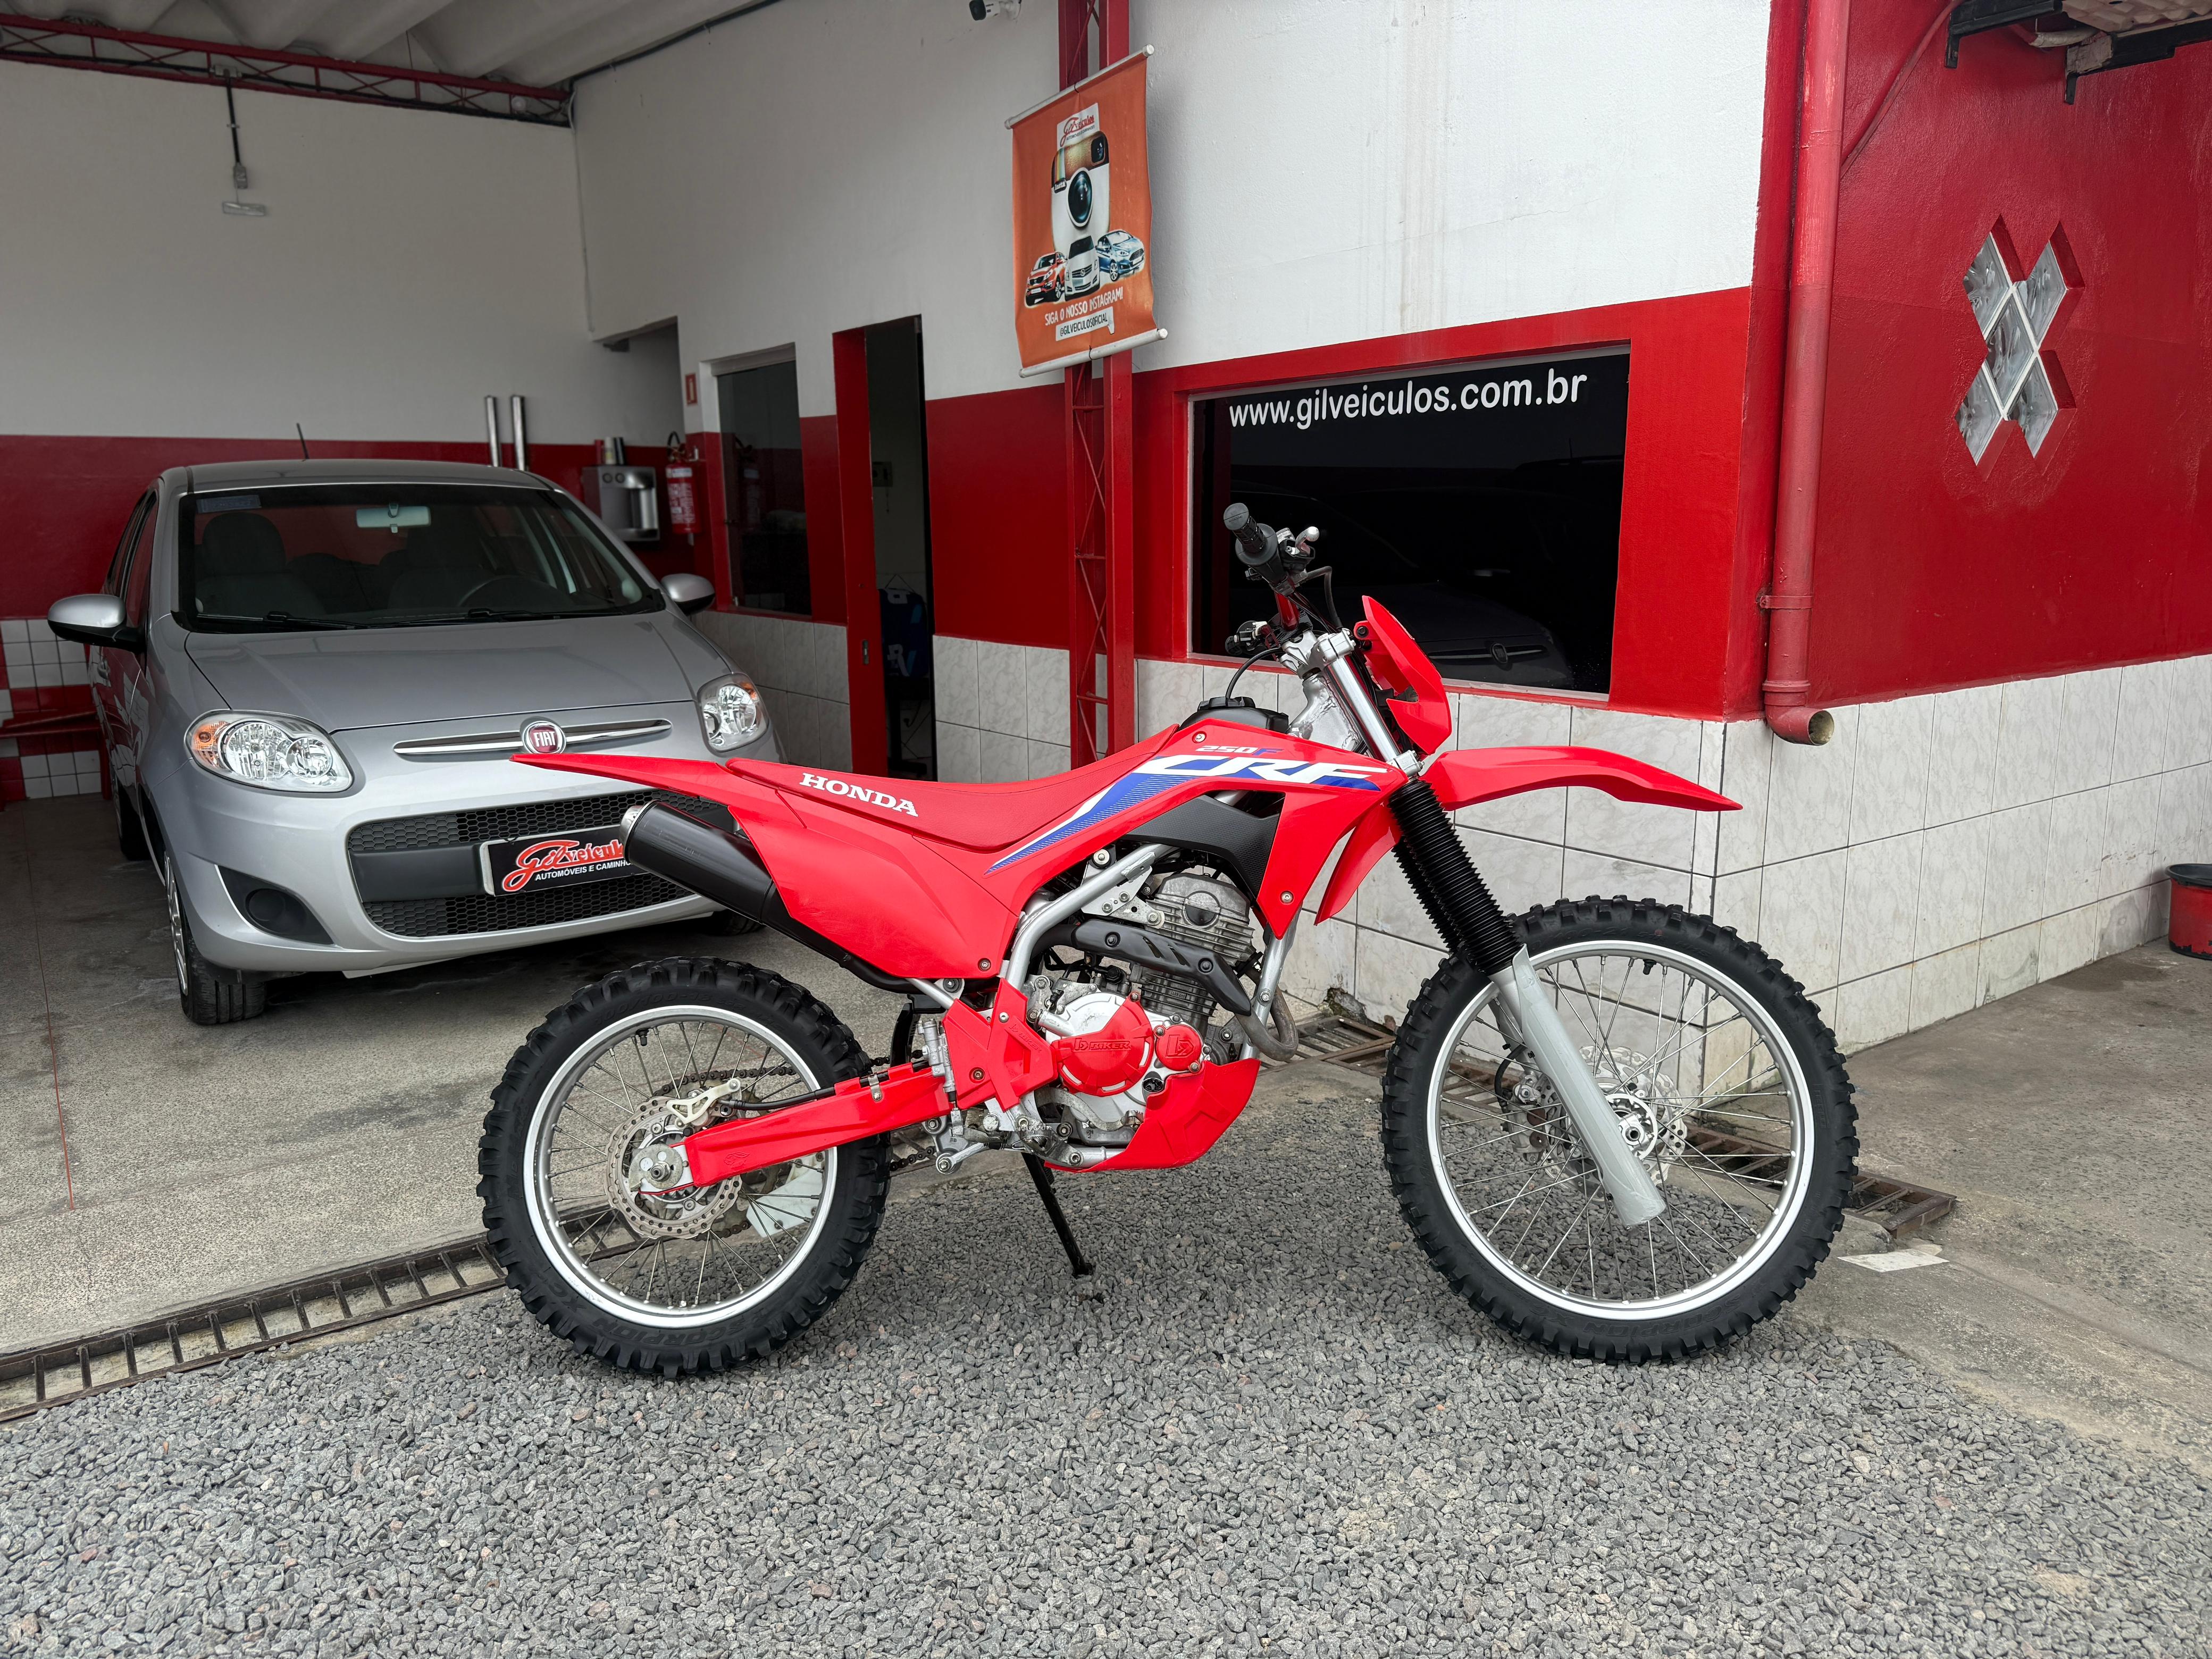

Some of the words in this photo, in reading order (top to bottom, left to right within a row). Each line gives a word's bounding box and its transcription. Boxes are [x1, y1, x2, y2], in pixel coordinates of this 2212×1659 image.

[1045, 311, 1059, 326] SIGA
[1060, 308, 1064, 321] O
[1066, 301, 1088, 319] NOSSO
[1090, 286, 1124, 312] INSTAGRAM!
[1060, 313, 1108, 337] @GILVEICULOSOFICIAL
[1229, 368, 1587, 430] www.gilveiculos.com.br
[533, 731, 556, 747] FIAT
[1195, 745, 1285, 756] 250F
[1133, 754, 1389, 784] CRF
[799, 772, 919, 817] HONDA
[535, 866, 588, 881] AUTOMÓVEIS
[596, 860, 633, 870] CAMINH
